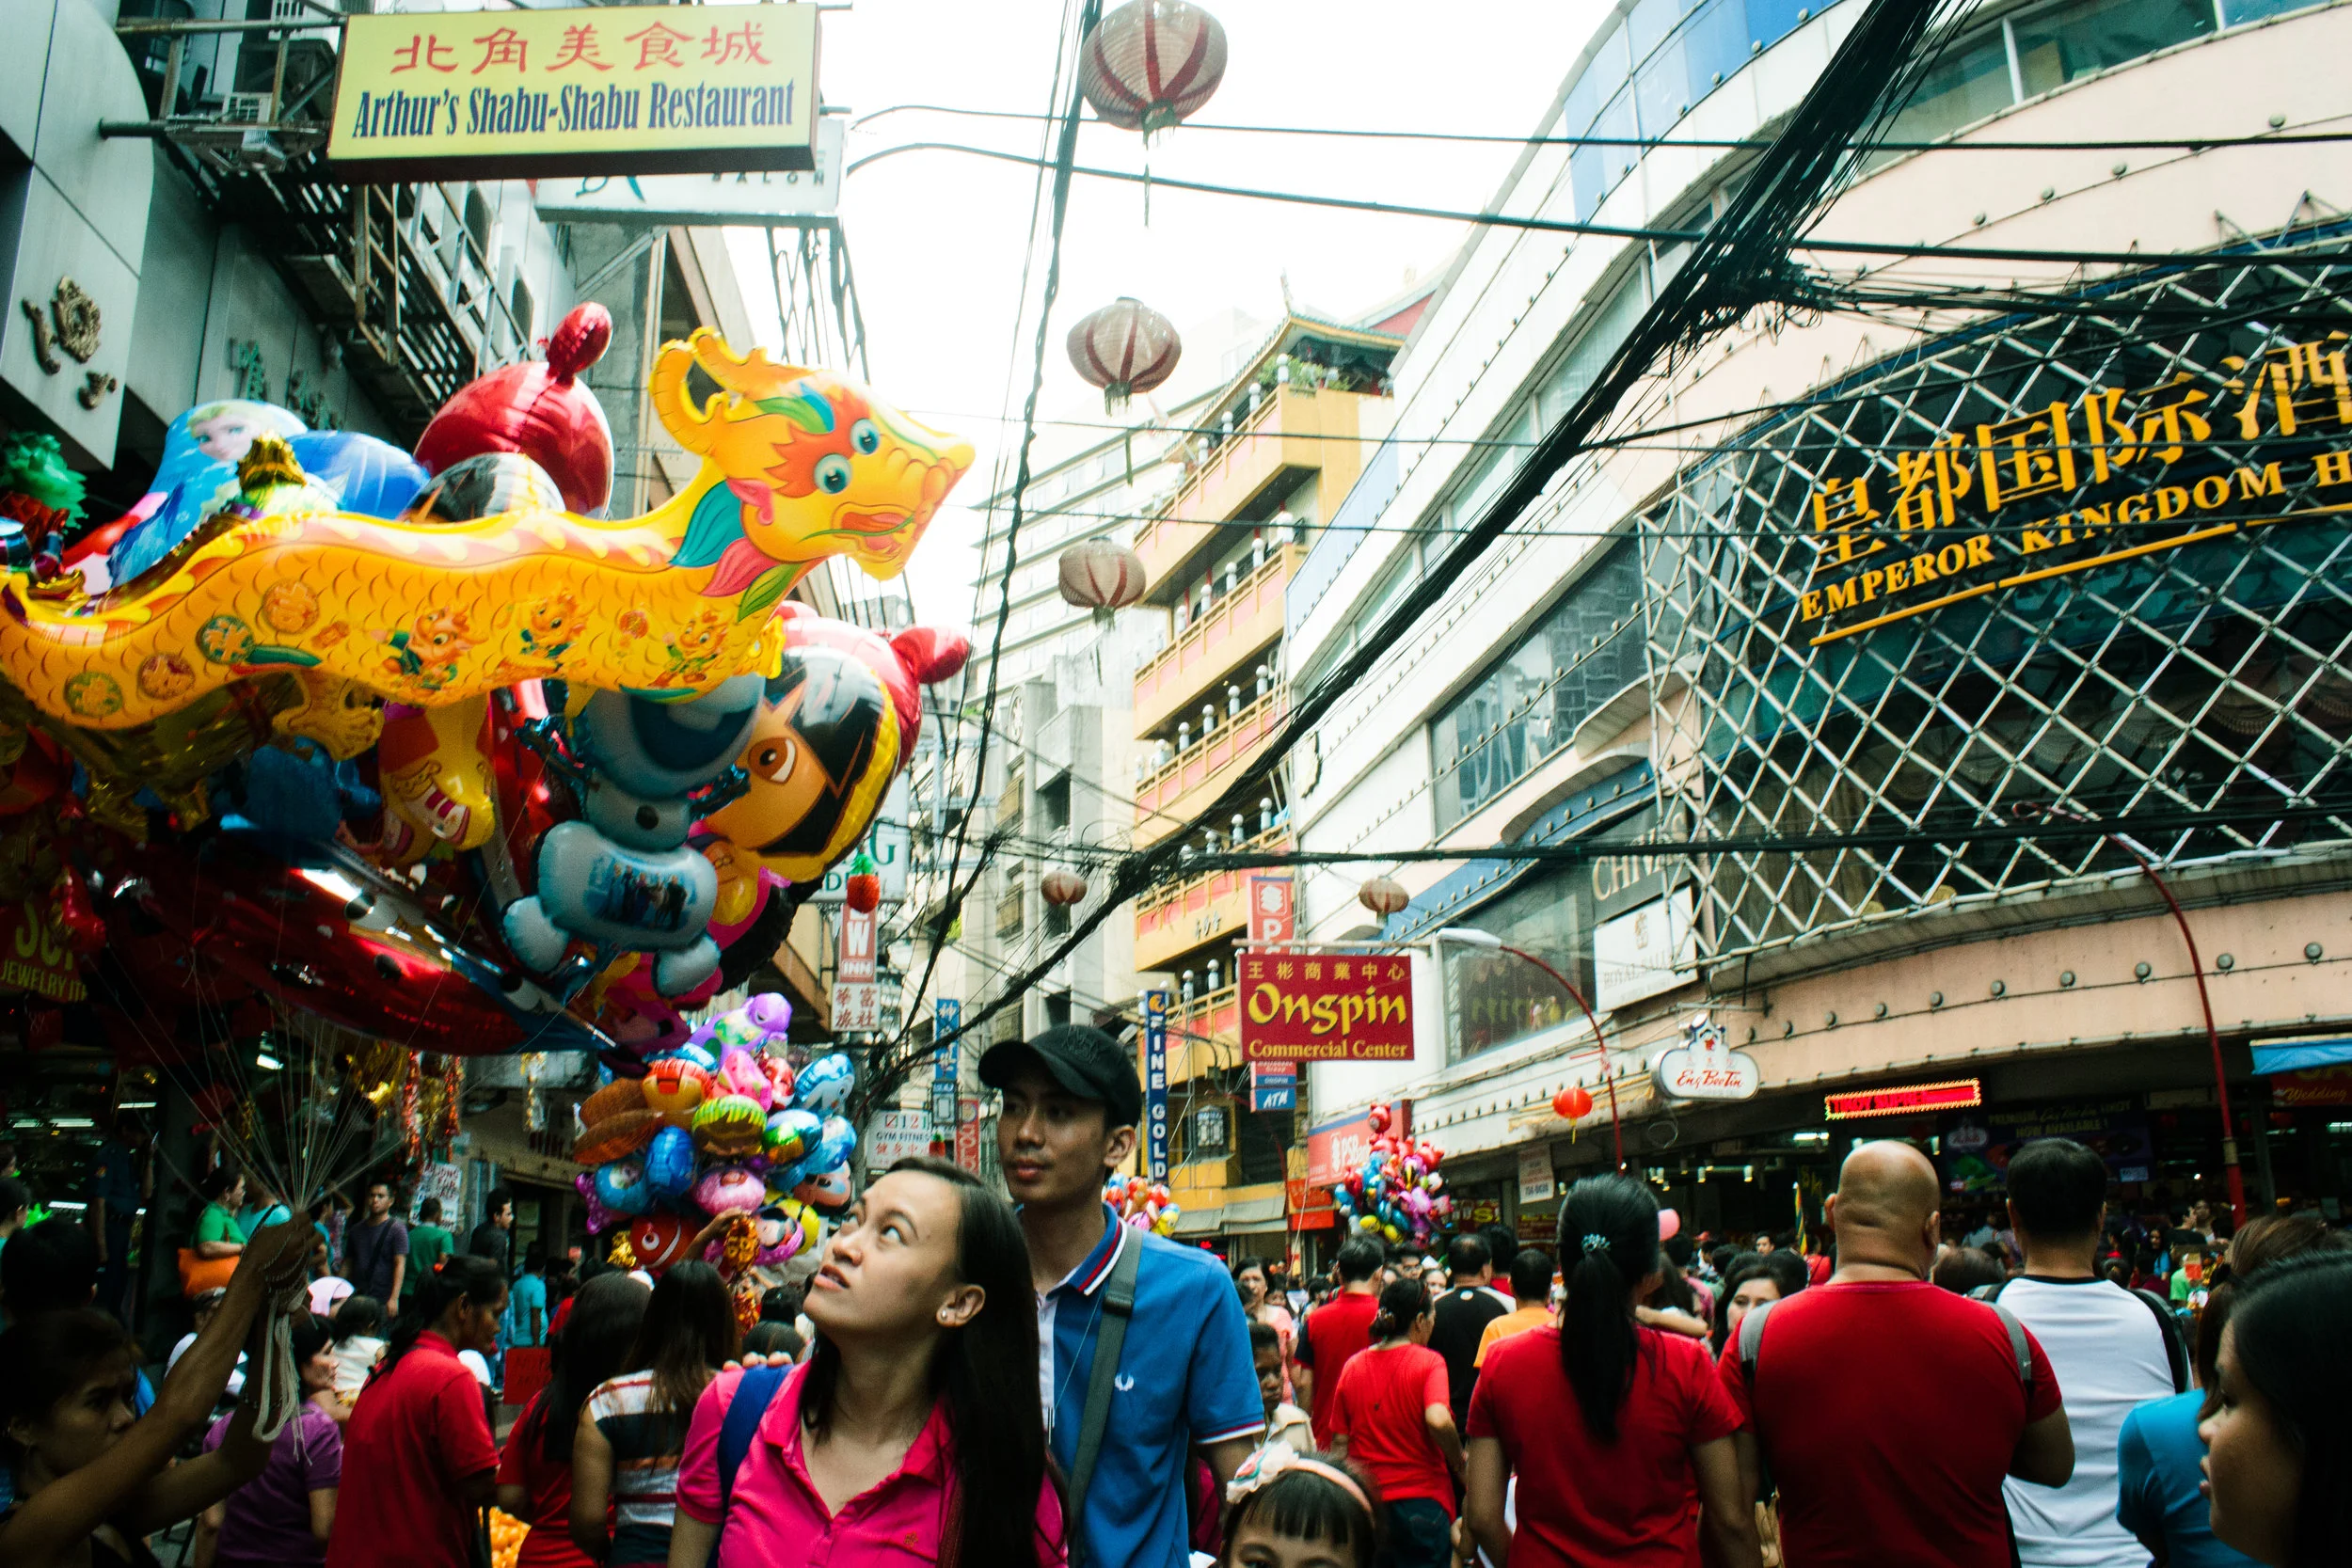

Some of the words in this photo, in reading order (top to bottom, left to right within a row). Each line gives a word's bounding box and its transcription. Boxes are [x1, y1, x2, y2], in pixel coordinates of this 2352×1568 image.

[390, 20, 773, 76] 北角美食城
[351, 87, 461, 140] Arthur's
[466, 81, 641, 136] Shabu-Shabu
[647, 77, 795, 130] Restaurant
[1800, 533, 1995, 623] EMPEROR
[2021, 459, 2287, 556] KINGDOM
[1, 959, 68, 999] JEWELRY
[1248, 960, 1406, 981] 王彬商業中心
[1248, 981, 1407, 1037] Ongpin
[1248, 1038, 1348, 1059] Commercial
[1352, 1038, 1407, 1059] Center
[1263, 1088, 1289, 1109] ATM
[876, 1131, 898, 1142] GYM
[1152, 1103, 1167, 1179] GOLD
